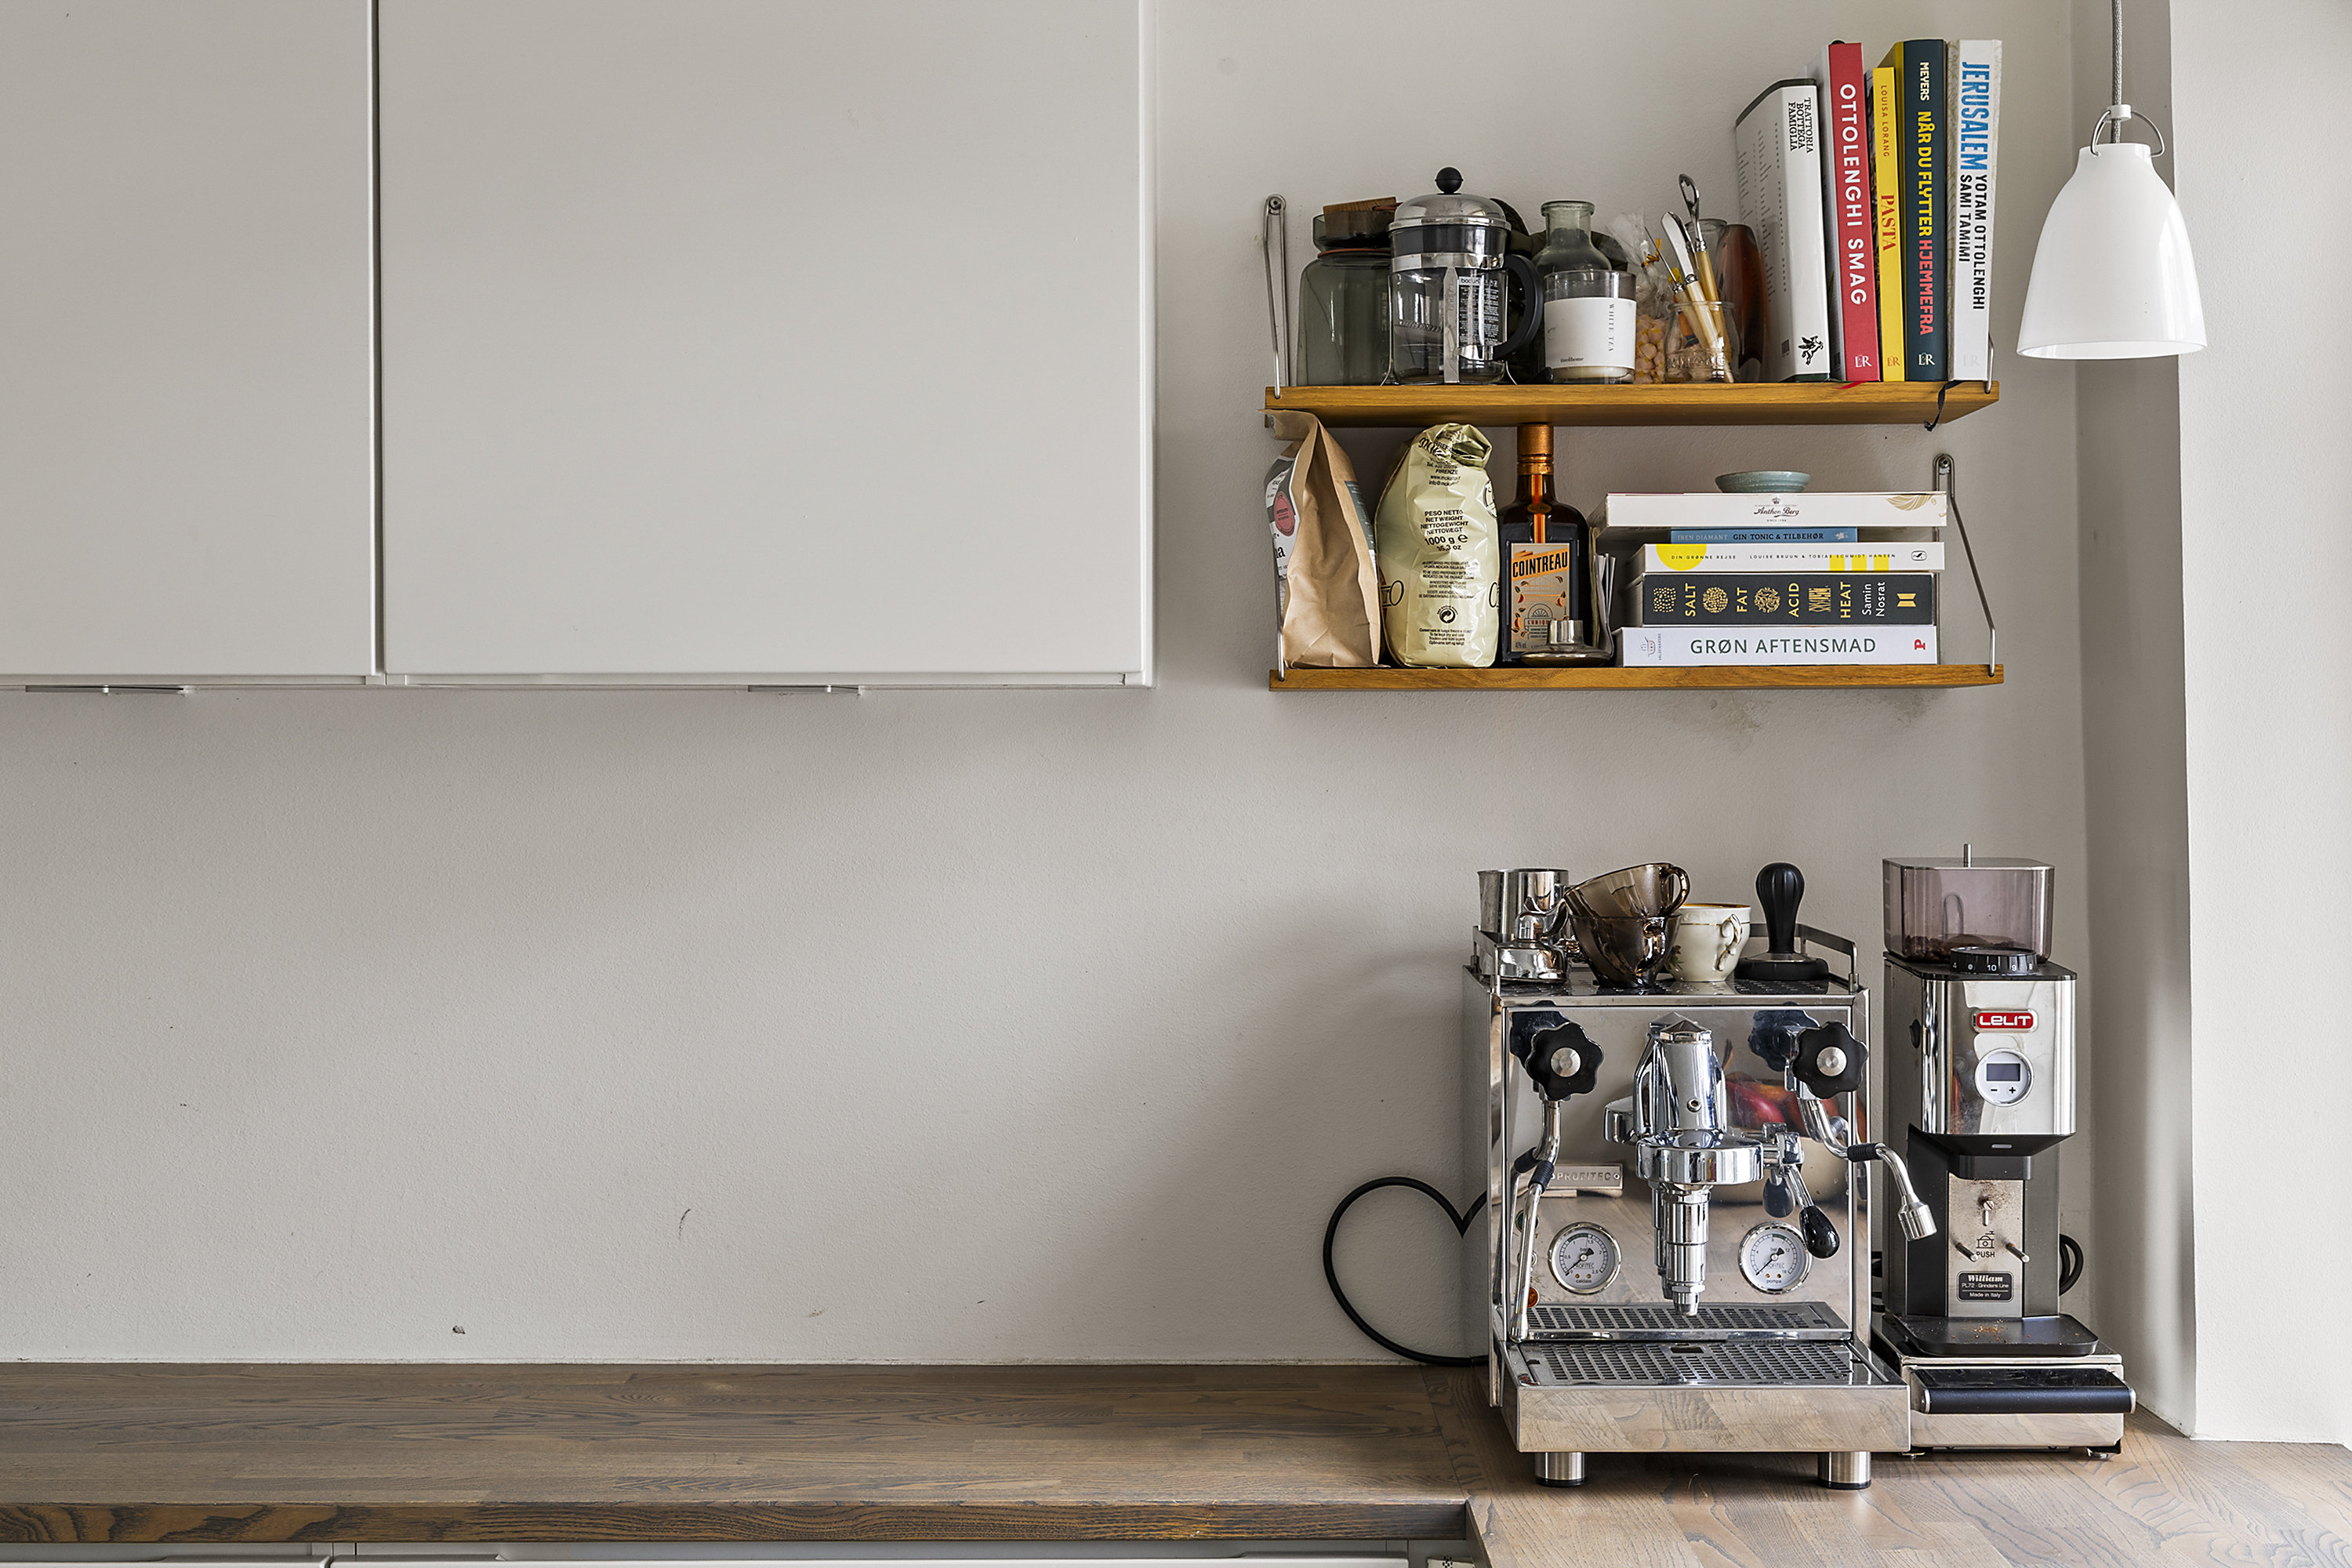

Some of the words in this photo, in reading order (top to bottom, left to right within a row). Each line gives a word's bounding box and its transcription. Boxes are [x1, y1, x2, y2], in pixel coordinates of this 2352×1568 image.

[1920, 62, 1929, 101] MEYERS
[1788, 102, 1797, 151] FAMIGLIA
[1804, 97, 1813, 153] TRATTORIA
[1918, 111, 1935, 143] NÅR
[1960, 62, 1990, 170] JERUSALEM
[1840, 84, 1862, 226] OTTOLENGHI
[1918, 147, 1932, 168] DU
[1918, 172, 1932, 237] FLYTTER
[1960, 174, 1972, 208] SAMI
[1975, 175, 1987, 220] YOTAM
[1882, 194, 1896, 251] PASTA
[1958, 212, 1971, 262] TAMIMI
[1848, 238, 1867, 305] SMAG
[1973, 225, 1987, 310] OTTOLENGHI
[1919, 240, 1933, 336] HJEMMEFRA
[1421, 521, 1468, 529] NETTOGEWICHT
[1754, 506, 1781, 515] Anthon
[1781, 506, 1799, 517] Berg
[1425, 536, 1446, 546] 1000
[1512, 551, 1568, 578] COINTREAU
[1685, 583, 1696, 617] SALT
[1737, 587, 1748, 612] FAT
[1788, 583, 1799, 618] ACID
[1840, 582, 1851, 618] HEAT
[1862, 583, 1871, 615] Samin
[1875, 582, 1886, 616] Nosrat
[1690, 639, 1747, 654] GRØN
[1755, 638, 1876, 654] AFTENSMAD
[1556, 1172, 1612, 1181] PROFITEC
